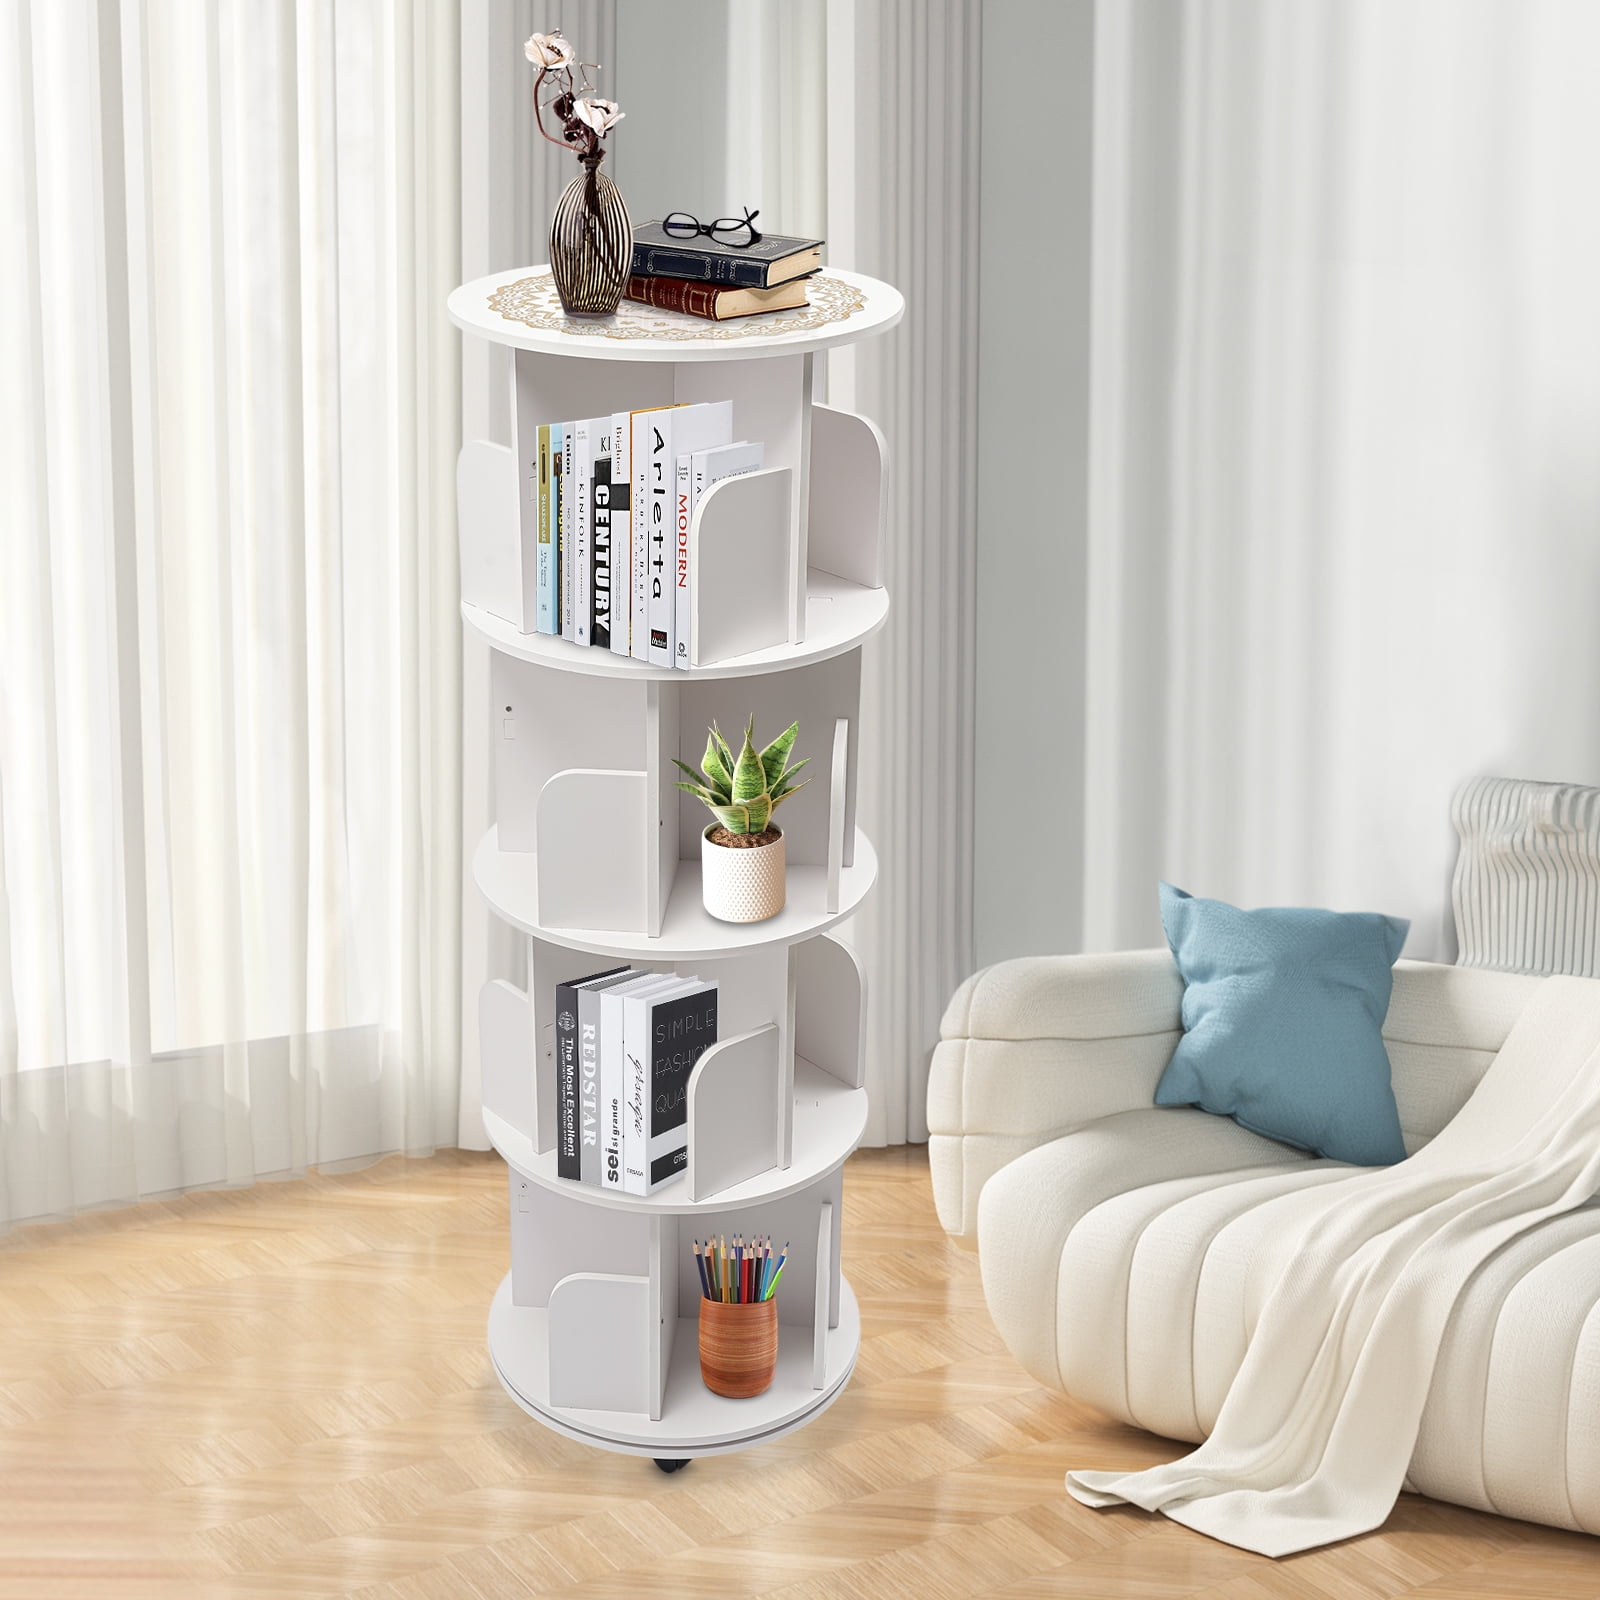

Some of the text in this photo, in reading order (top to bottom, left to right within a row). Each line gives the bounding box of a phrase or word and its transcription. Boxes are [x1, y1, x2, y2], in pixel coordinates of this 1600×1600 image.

[595, 484, 610, 632] CENTURY
[652, 426, 665, 599] Arletta
[678, 494, 688, 588] MODERN
[583, 1023, 597, 1147] REDSTAR
[656, 1008, 715, 1043] SIMPLE
[566, 1037, 575, 1157] The Most Excellent
[605, 1147, 619, 1183] sei
